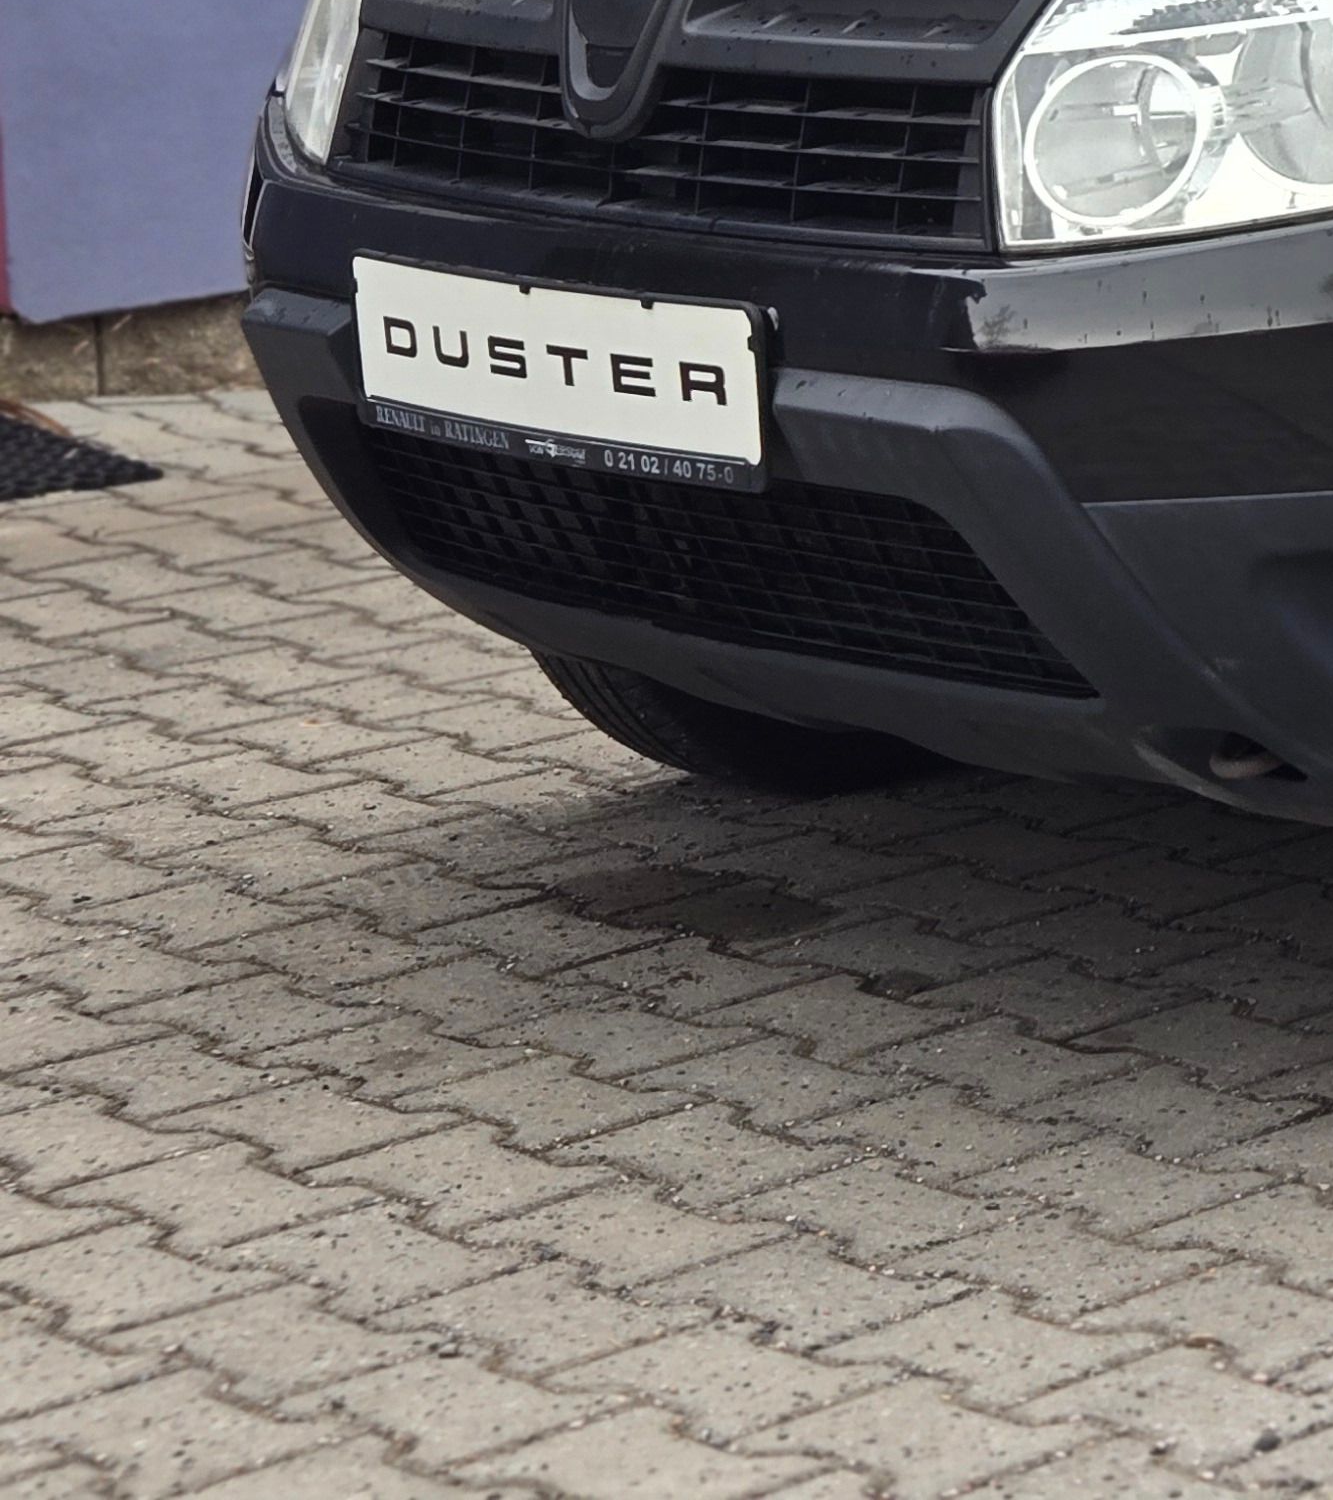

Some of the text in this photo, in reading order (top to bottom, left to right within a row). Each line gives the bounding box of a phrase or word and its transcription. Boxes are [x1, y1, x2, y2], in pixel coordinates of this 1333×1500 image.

[382, 315, 728, 407] DUSTER
[375, 404, 425, 433] RENAULT
[443, 419, 509, 449] RATINGEN
[604, 449, 614, 467] 0
[618, 452, 635, 471] 21
[640, 455, 661, 475] 02
[672, 460, 693, 479] 40
